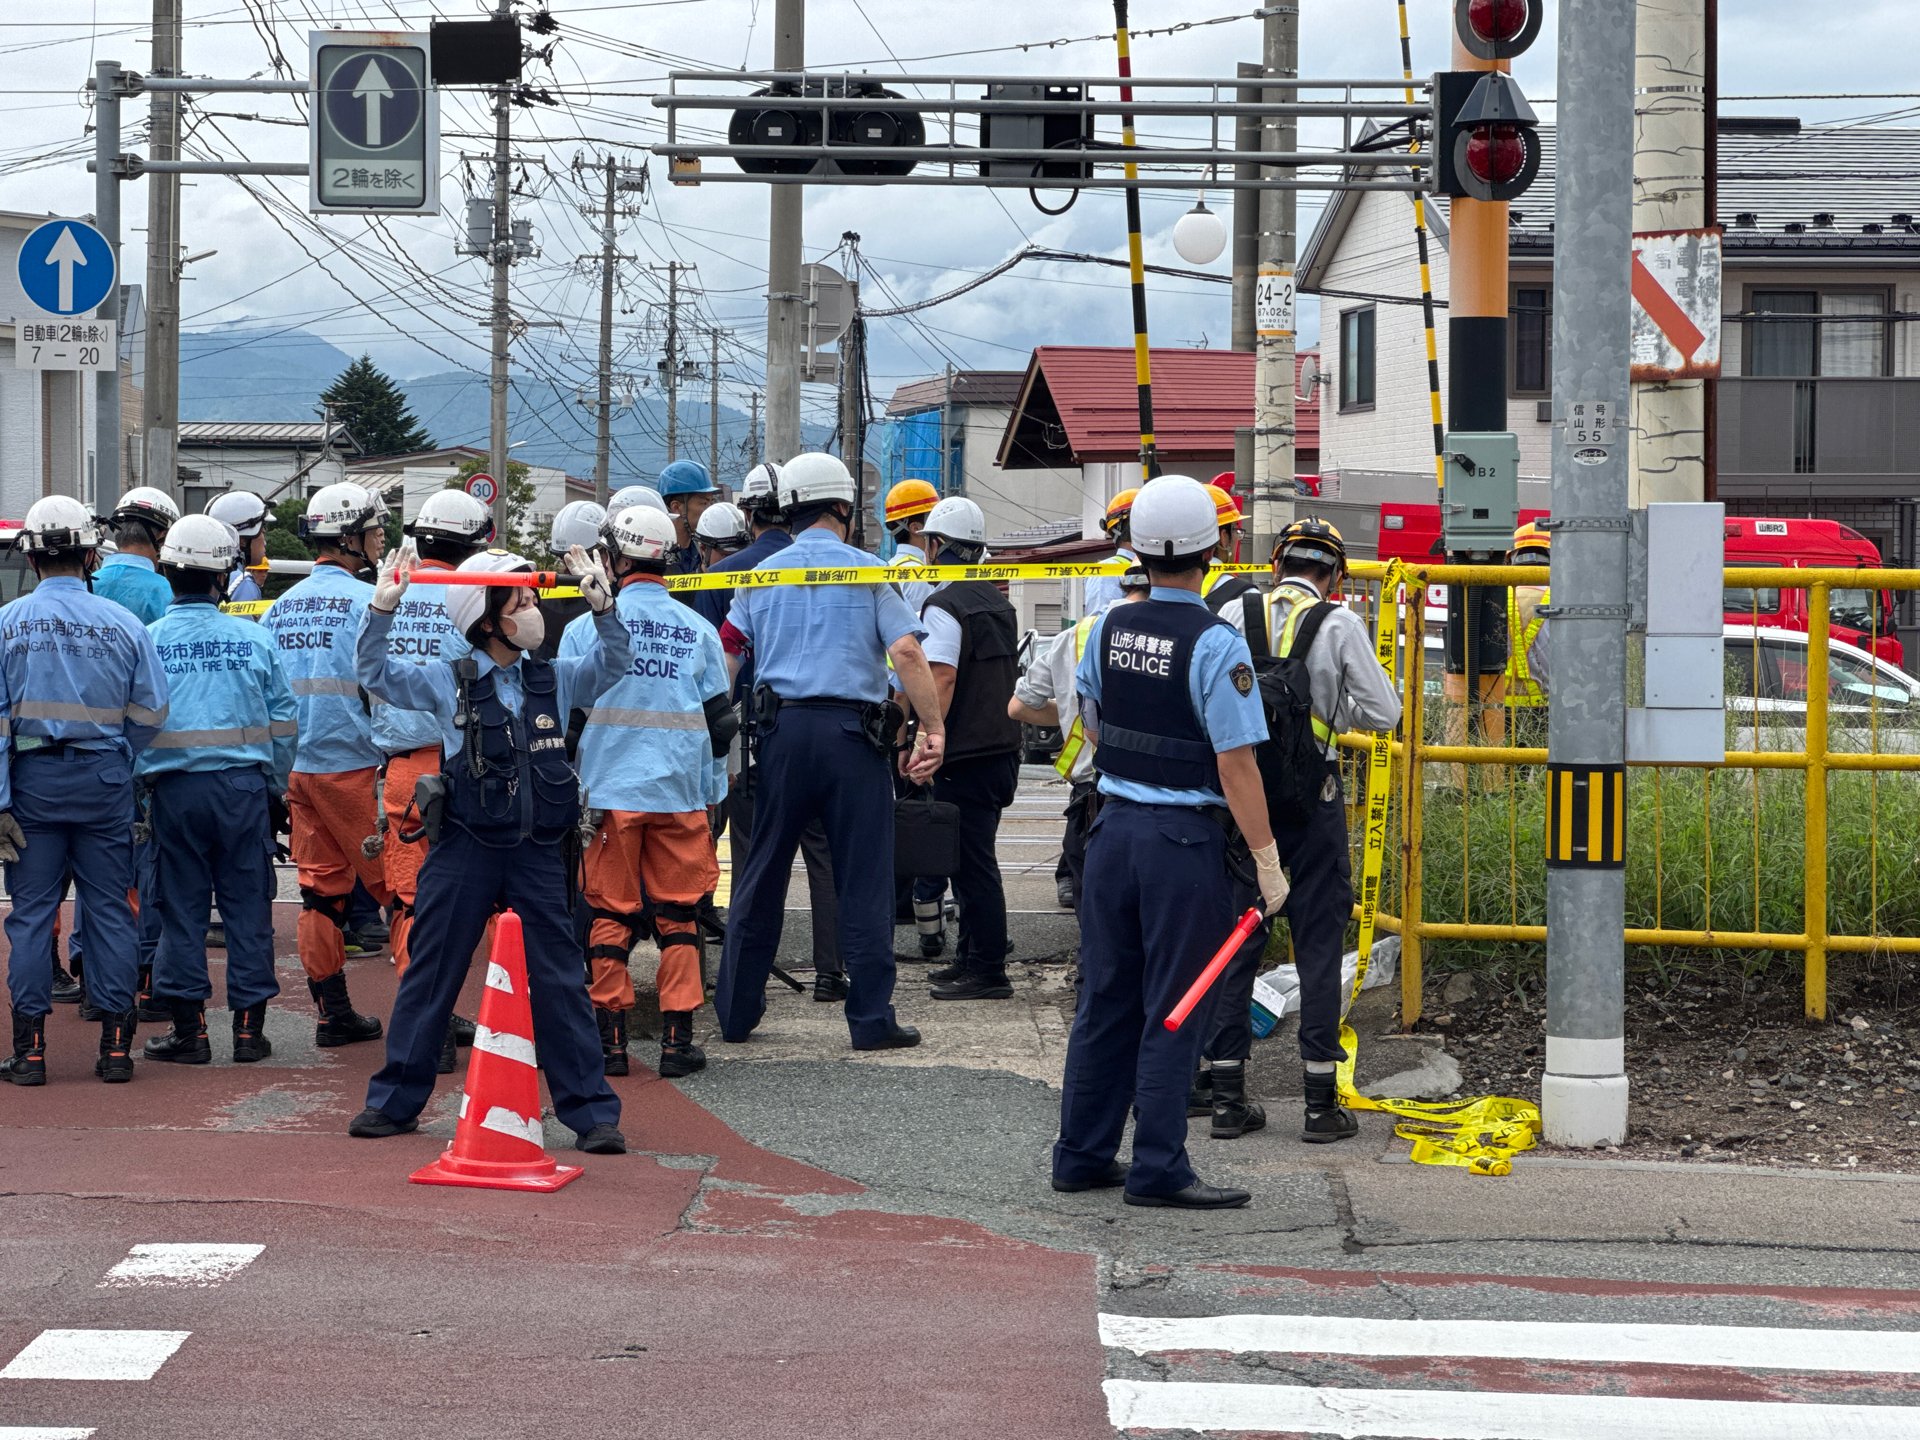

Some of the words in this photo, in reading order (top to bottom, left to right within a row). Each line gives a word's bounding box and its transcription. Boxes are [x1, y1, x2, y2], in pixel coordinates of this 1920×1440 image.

[332, 167, 416, 190] 2輪を除く
[1257, 283, 1293, 306] 24-2
[23, 324, 108, 343] 自動車(2輪を除く)
[31, 345, 41, 364] 7
[79, 347, 99, 365] 20
[1574, 417, 1606, 429] 山形
[1577, 430, 1602, 442] 55
[473, 483, 491, 498] 30
[726, 571, 781, 586] 立入禁止
[883, 568, 940, 580] 立入禁止
[271, 597, 352, 618] 山形市消防本部
[3, 618, 118, 643] 山形市消防本部
[412, 622, 430, 633] FIRE
[278, 631, 333, 650] RESCUE
[651, 643, 669, 655] FIRE
[1110, 631, 1174, 657] 山形県警察
[61, 643, 82, 658] FIRE
[1380, 629, 1393, 680] 入禁止
[202, 660, 223, 672] FIRE
[1108, 650, 1171, 677] POLICE
[1368, 792, 1387, 851] 立入禁止
[1362, 874, 1379, 929] 山形県警
